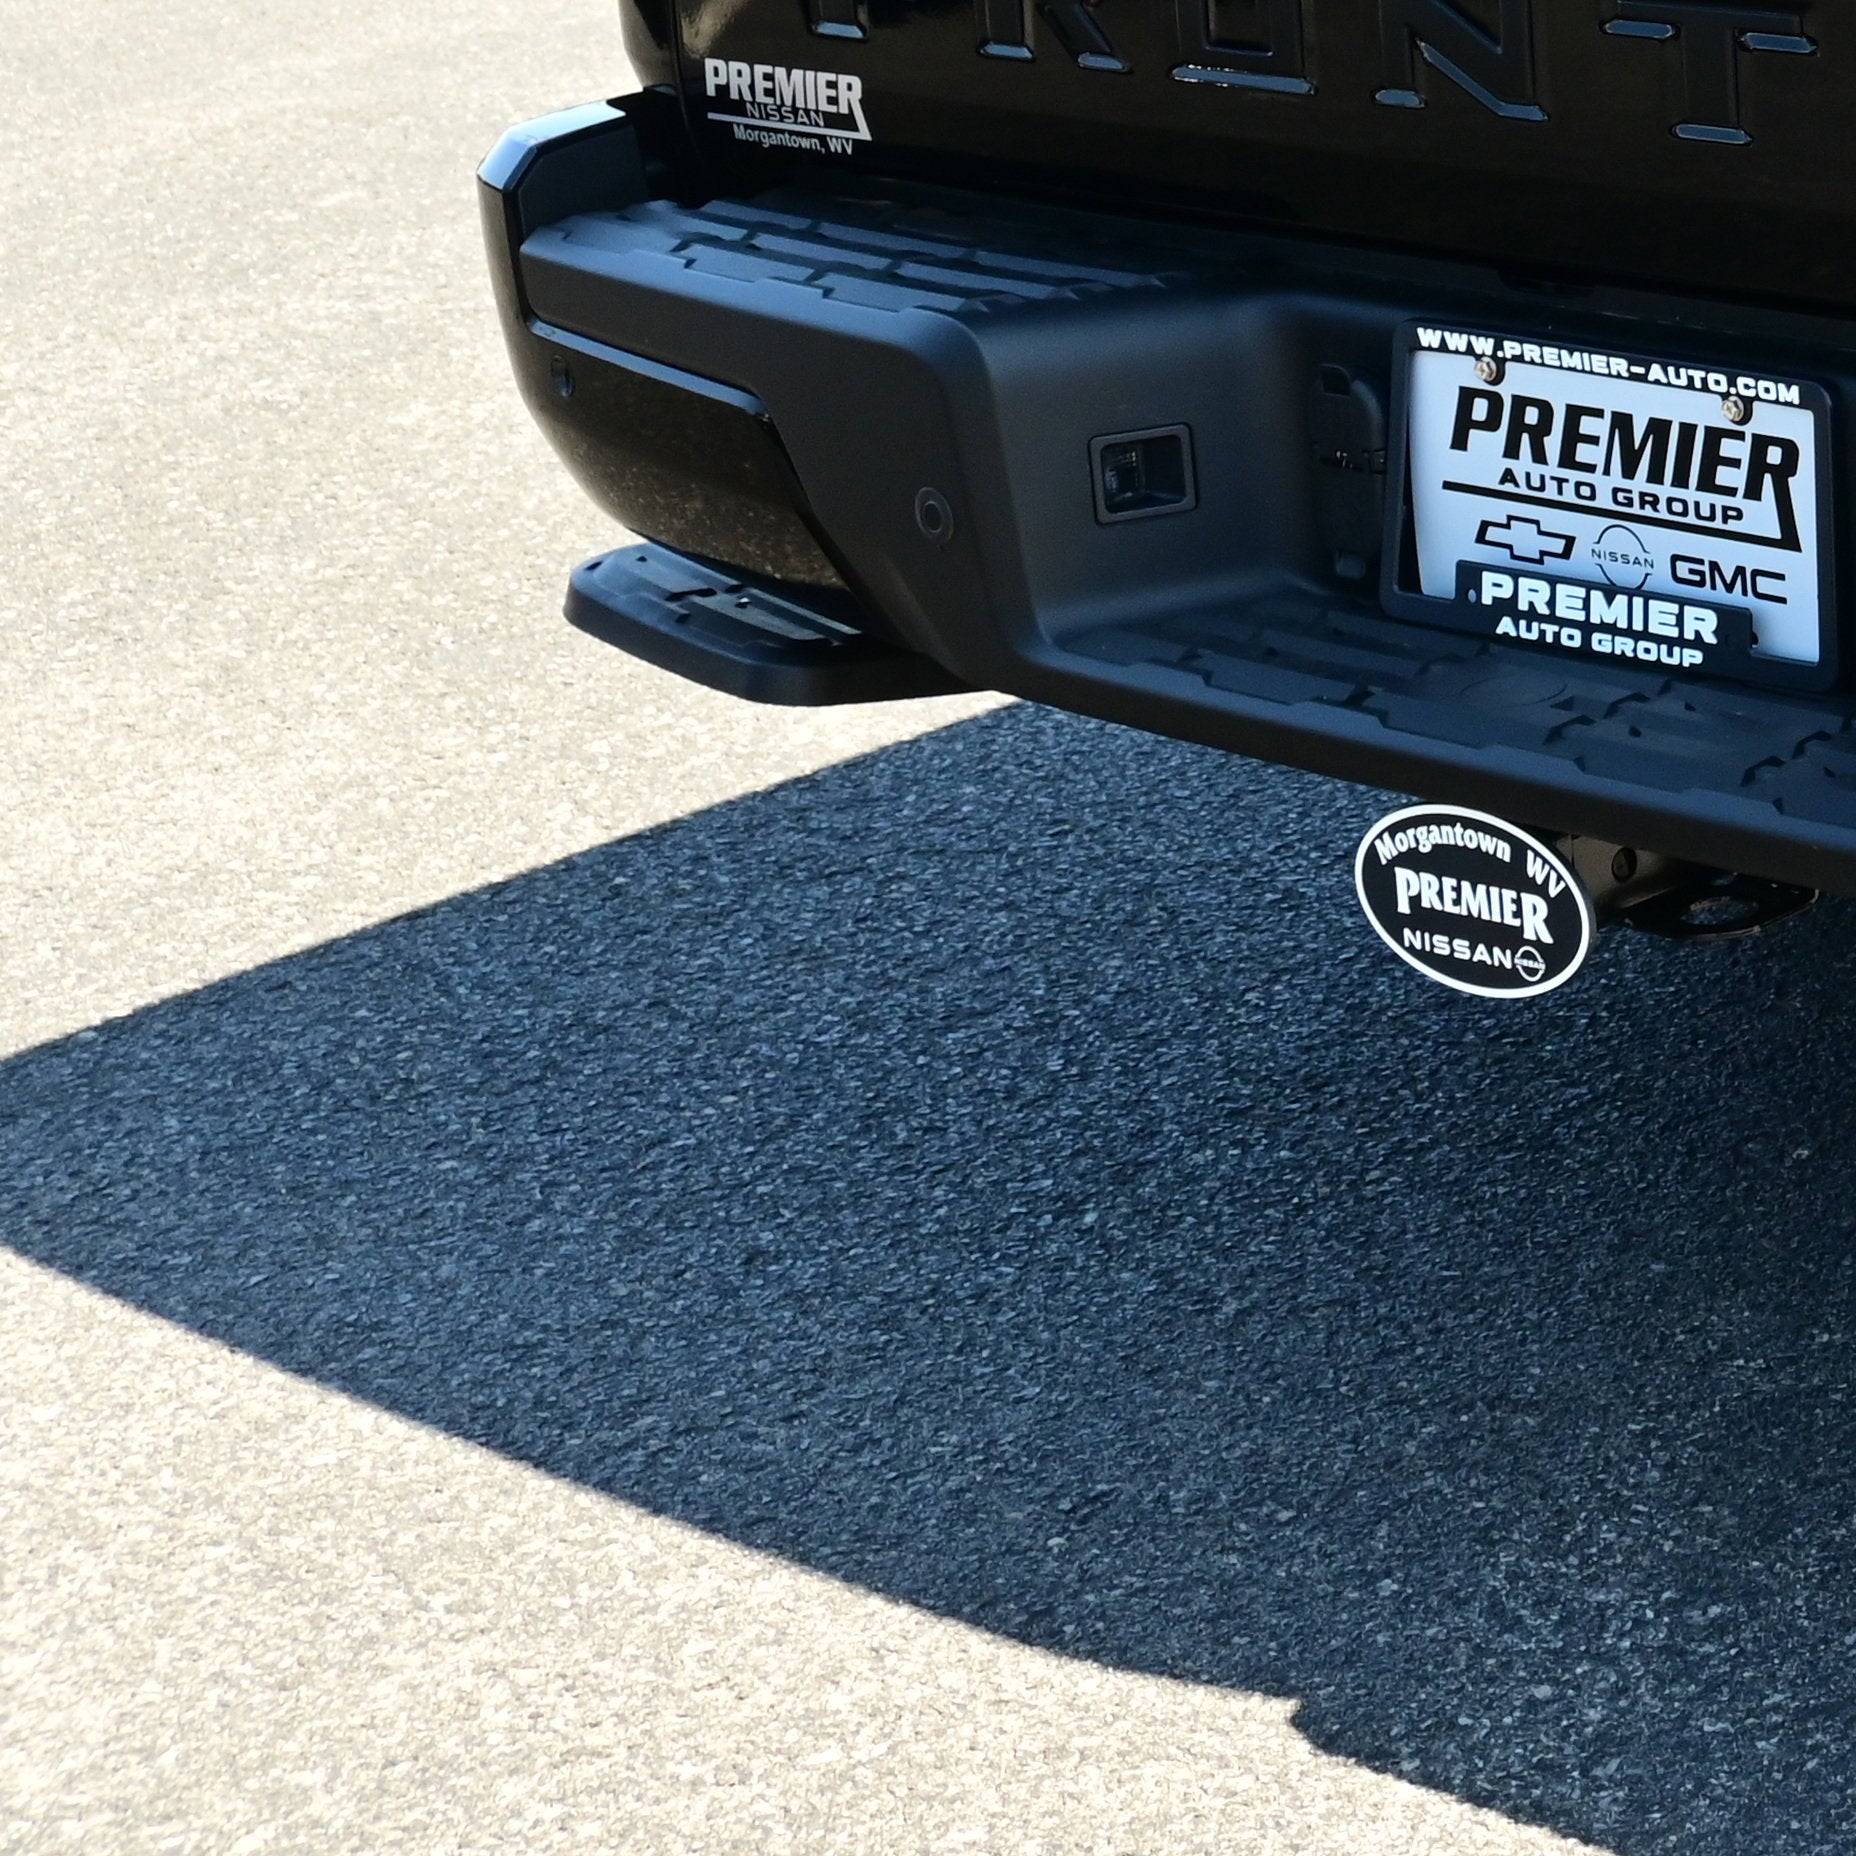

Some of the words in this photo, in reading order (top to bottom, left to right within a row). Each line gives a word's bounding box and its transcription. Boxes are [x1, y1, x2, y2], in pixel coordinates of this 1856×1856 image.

[704, 57, 868, 118] PREMIER
[746, 101, 825, 127] NISSAN
[732, 123, 826, 154] Morgantown,
[827, 136, 853, 156] WV
[1416, 326, 1801, 406] WWW.PREMIER-AUTO.COM
[1449, 384, 1802, 526] PREMIER
[1498, 467, 1598, 502] AUTO
[1610, 488, 1744, 526] GROUP
[1591, 547, 1655, 570] NISSAN
[1669, 553, 1788, 605] GMC
[1480, 571, 1718, 644] PREMIER
[1495, 616, 1582, 649] AUTO
[1591, 633, 1704, 669] GROUP
[1373, 822, 1512, 865] Morgantown
[1526, 849, 1566, 899] WV
[1393, 866, 1554, 945] PREMIER
[1402, 927, 1513, 970] NISSAN
